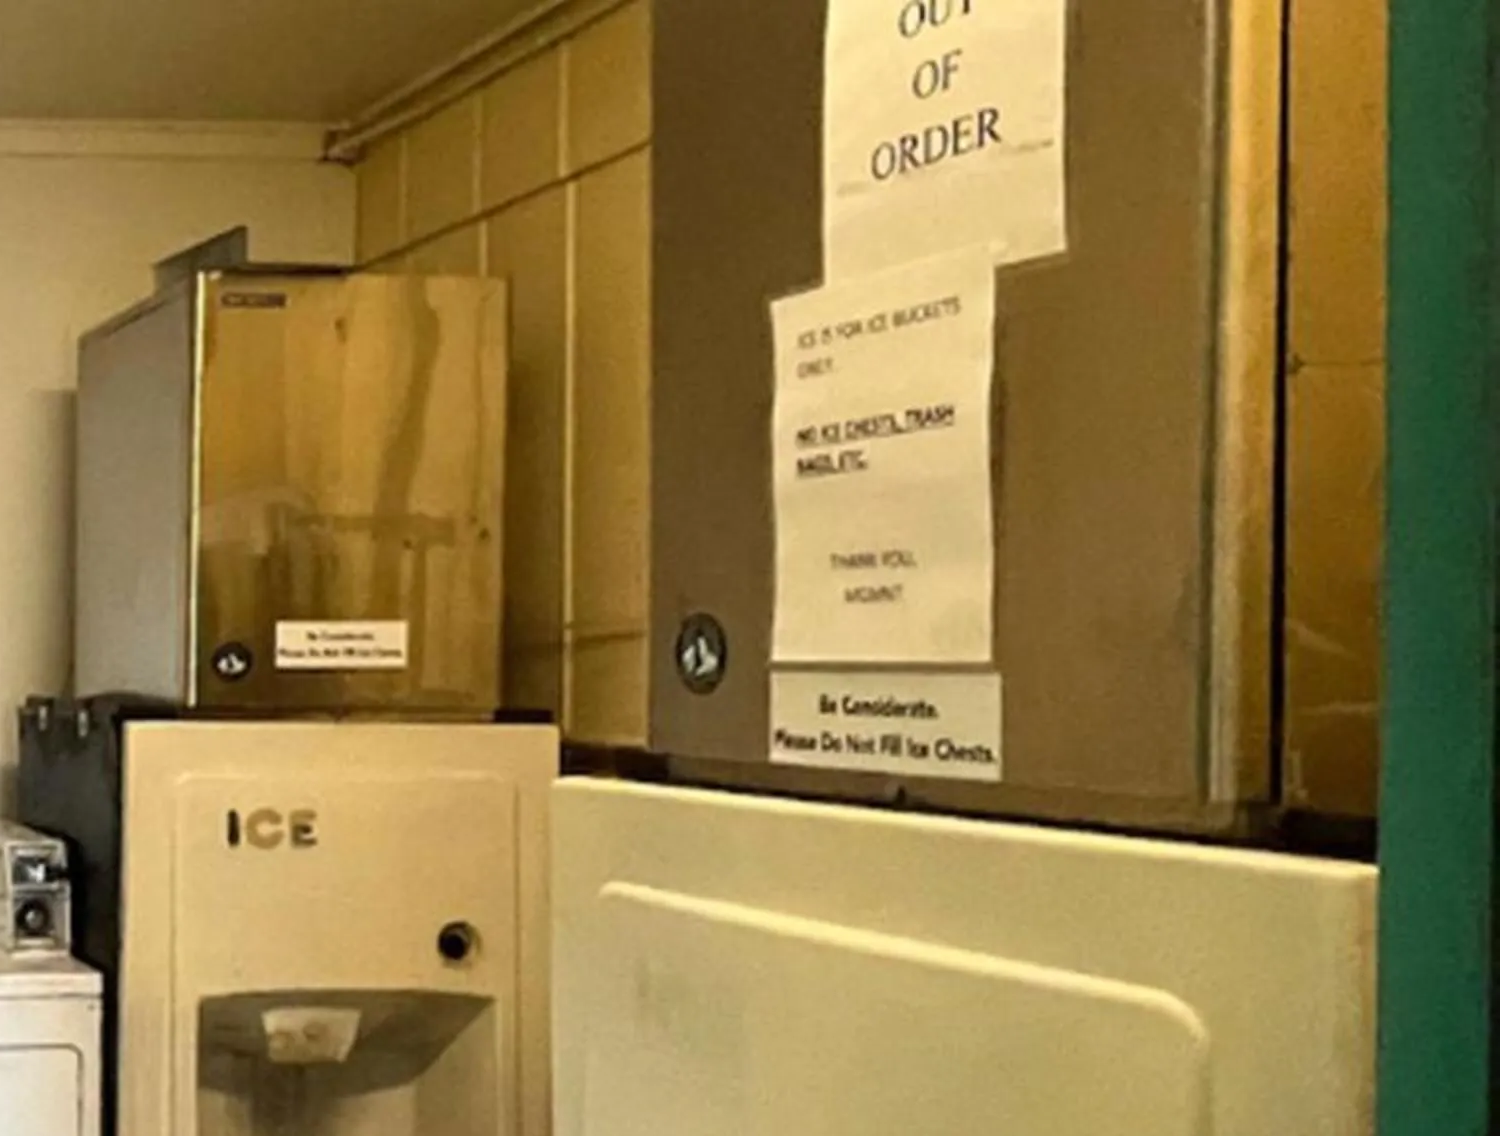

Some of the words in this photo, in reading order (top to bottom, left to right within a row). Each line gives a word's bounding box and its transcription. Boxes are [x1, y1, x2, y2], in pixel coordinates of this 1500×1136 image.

[911, 48, 963, 100] OF
[869, 106, 1002, 182] ORDER
[904, 403, 956, 433] TRASH
[818, 693, 838, 715] Be
[841, 695, 940, 720] Considerate.
[820, 731, 843, 754] Do
[846, 734, 877, 756] Not
[880, 733, 902, 757] Fill
[907, 738, 930, 760] Ice
[226, 807, 319, 850] ICE
